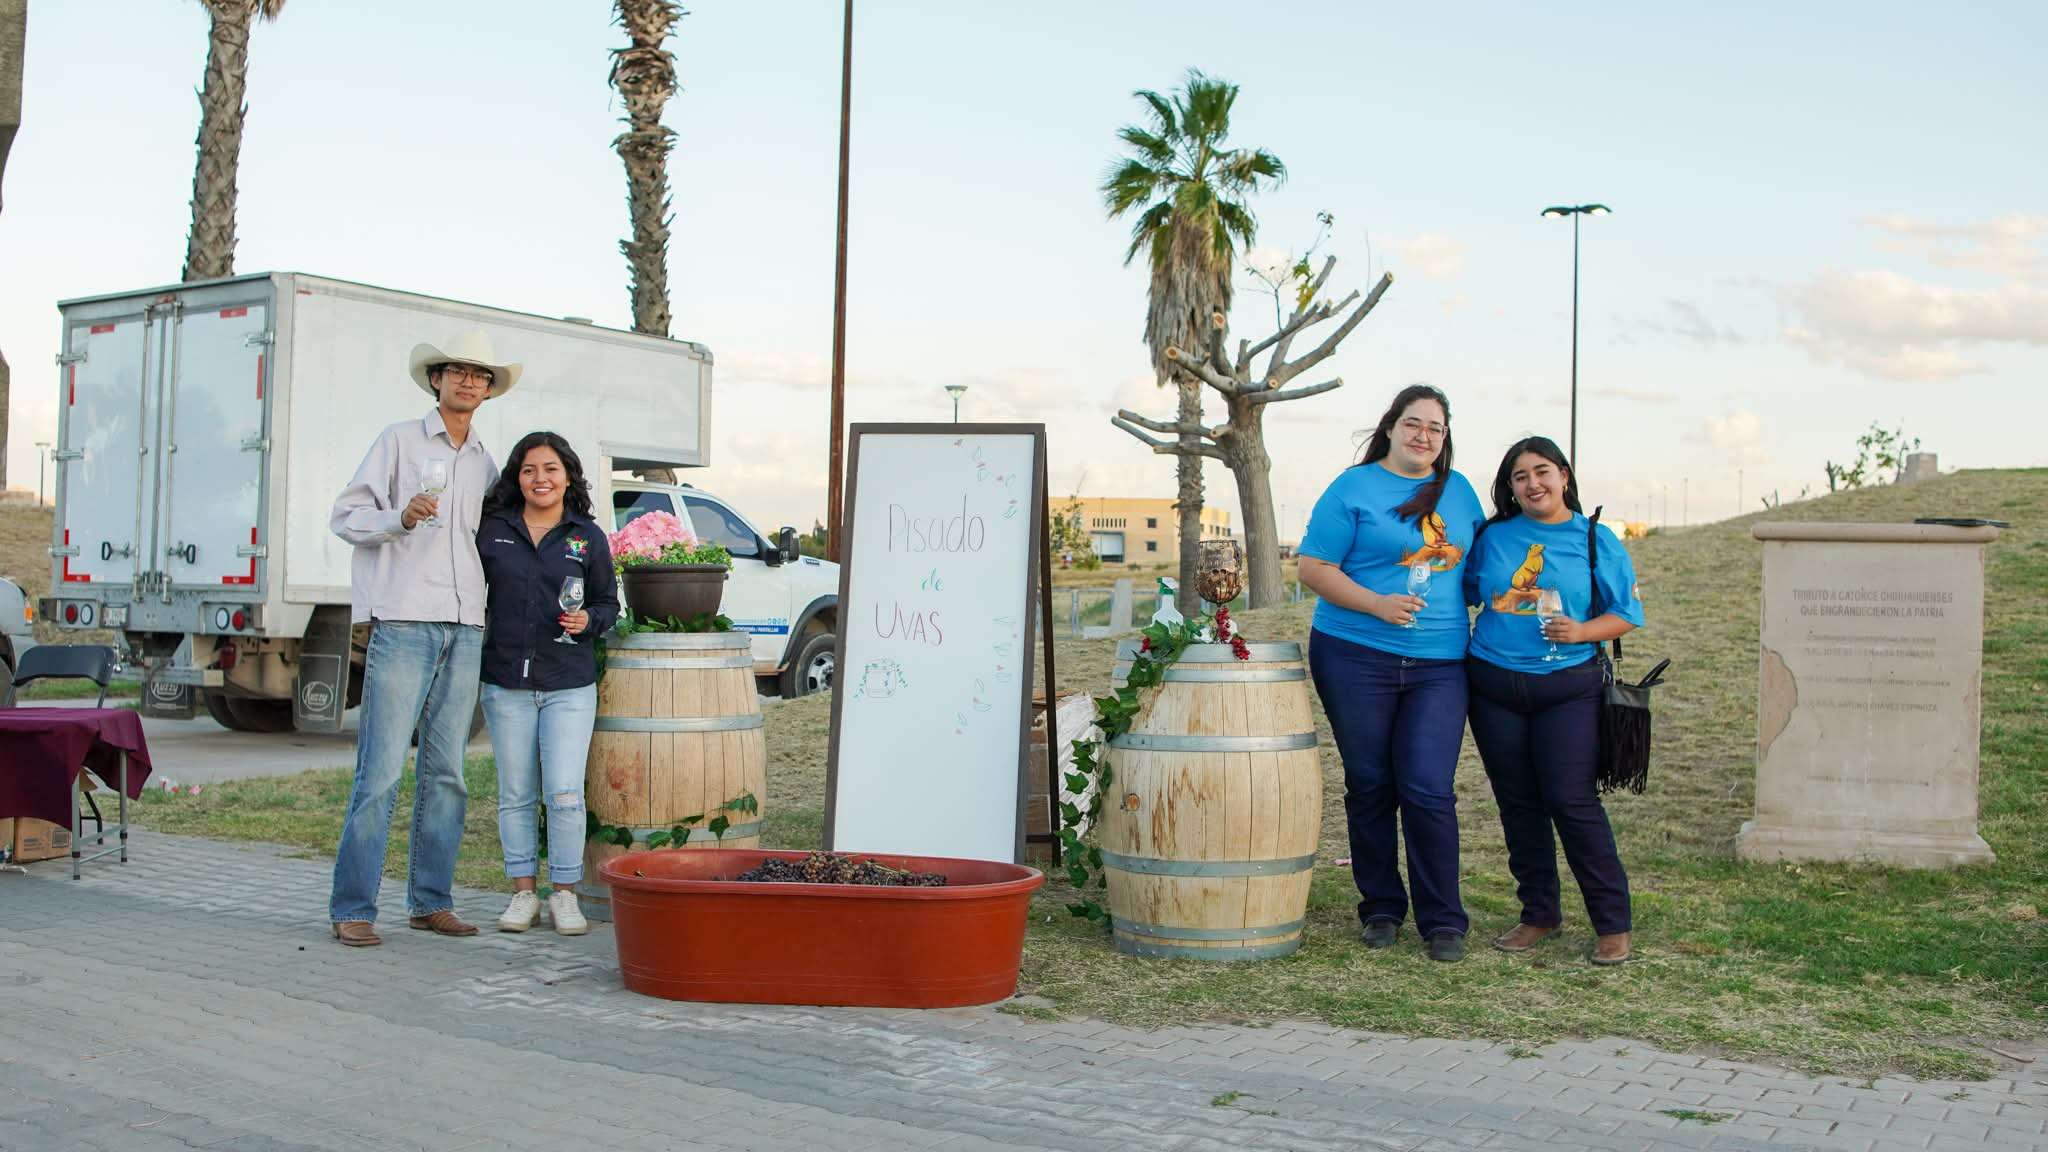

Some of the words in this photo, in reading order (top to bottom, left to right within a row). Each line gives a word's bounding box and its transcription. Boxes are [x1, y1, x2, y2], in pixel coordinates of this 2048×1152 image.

[920, 567, 943, 591] de
[1793, 590, 1829, 601] TRIBUTO
[1838, 591, 1878, 602] CATORCE
[1880, 592, 1953, 604] CHIHUAHUENSES
[1800, 605, 1819, 617] QUE
[1820, 606, 1898, 618] ENGRANDECIERON
[1901, 607, 1912, 617] LA
[1914, 607, 1945, 618] PATRIA
[875, 601, 943, 647] UVAS
